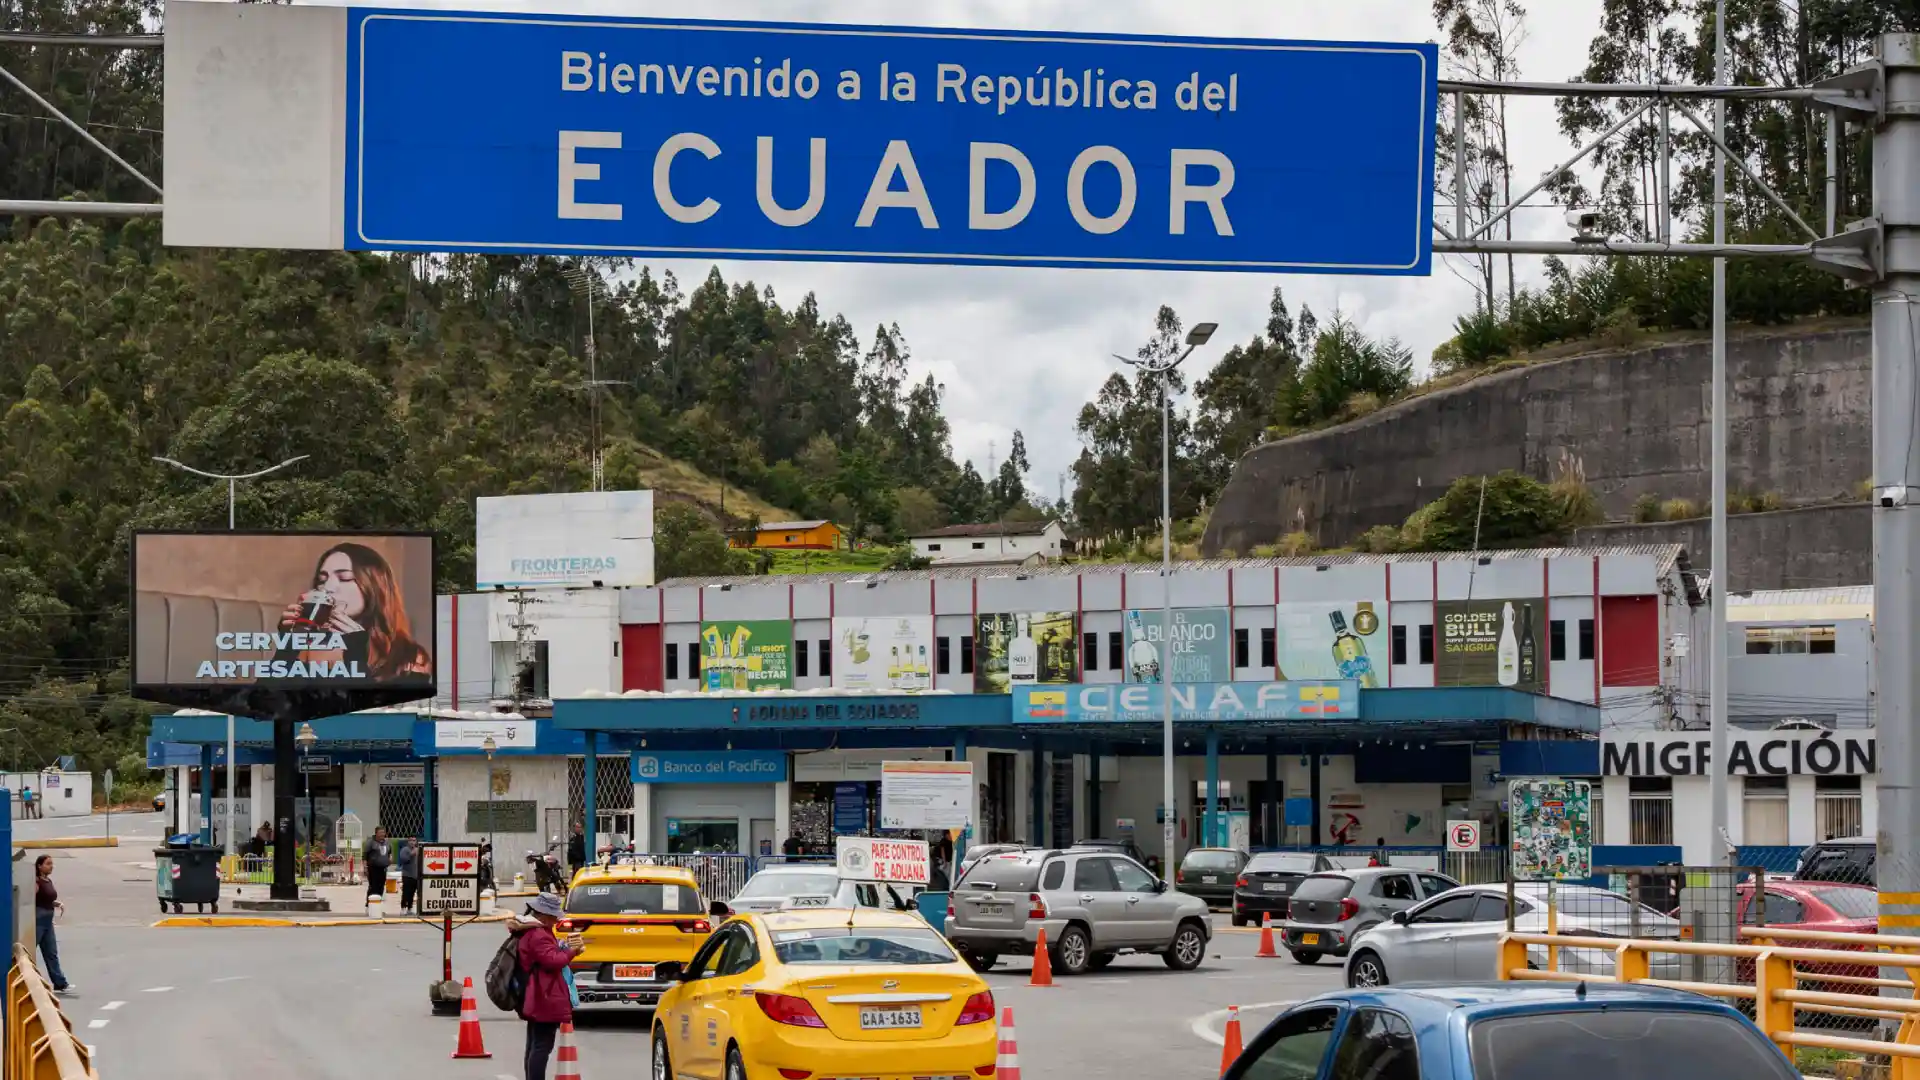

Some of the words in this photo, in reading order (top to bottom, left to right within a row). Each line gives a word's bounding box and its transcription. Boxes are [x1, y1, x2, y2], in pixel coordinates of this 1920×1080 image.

[560, 50, 820, 100] Bienvenido
[837, 73, 862, 101] a
[880, 62, 917, 102] la
[936, 63, 1157, 116] República
[1174, 73, 1239, 112] del
[556, 130, 1236, 237] ECUADOR
[511, 557, 617, 571] FRONTERAS
[1175, 612, 1188, 624] EL
[1445, 613, 1497, 622] GOLDEN
[1148, 623, 1216, 642] BLANCO
[1445, 623, 1497, 637] BULL
[216, 632, 348, 650] CERVEZA
[1172, 641, 1196, 653] QUE
[1445, 642, 1496, 653] SANGRIA
[196, 660, 366, 678] ARTESANAL
[748, 671, 787, 680] NECTAR
[1079, 683, 1288, 711] CENAF
[749, 704, 810, 721] ADUANA
[815, 704, 842, 720] DEL
[847, 703, 920, 720] ECUADOR
[664, 760, 702, 773] Banco
[706, 760, 724, 773] del
[424, 850, 449, 859] PESADOS
[871, 842, 890, 860] PARE
[891, 844, 926, 862] CONTROL
[874, 862, 886, 879] DE
[890, 863, 926, 881] ADUANA
[429, 879, 469, 888] ADUANA
[440, 889, 458, 898] DEL
[426, 900, 473, 909] ECUADOR
[861, 1011, 921, 1026] CAA-1633
